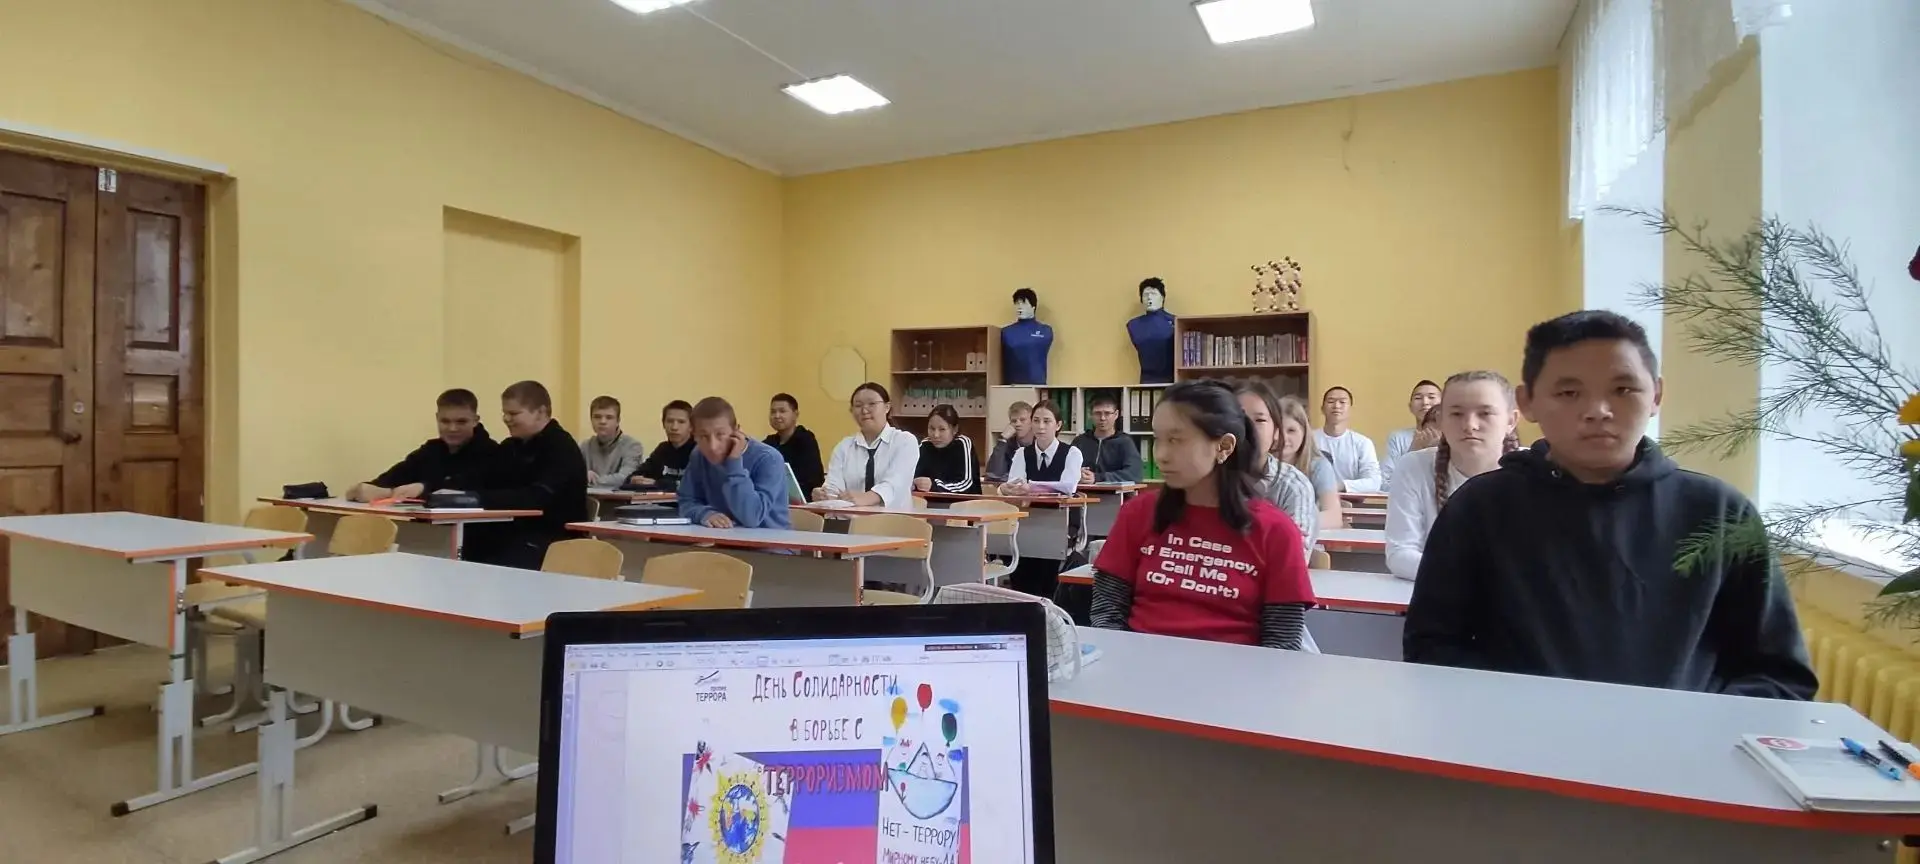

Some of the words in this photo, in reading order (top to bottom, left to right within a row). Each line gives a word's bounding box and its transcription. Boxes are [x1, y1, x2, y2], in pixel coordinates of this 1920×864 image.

[1168, 533, 1183, 546] In
[1188, 536, 1233, 553] Case
[1140, 545, 1155, 555] of
[1159, 547, 1258, 576] Emergency,
[1161, 560, 1194, 576] Call
[1199, 567, 1228, 582] Me
[1146, 571, 1175, 586] (Or
[1180, 578, 1240, 599] Don't)
[695, 692, 727, 702] ТЕРРОРА
[753, 674, 787, 702] ДЕНЬ
[804, 718, 849, 741] БОРЬБЕ
[764, 762, 889, 797] ТЕРРОРИЗМОМ
[882, 817, 902, 837] НЕТ
